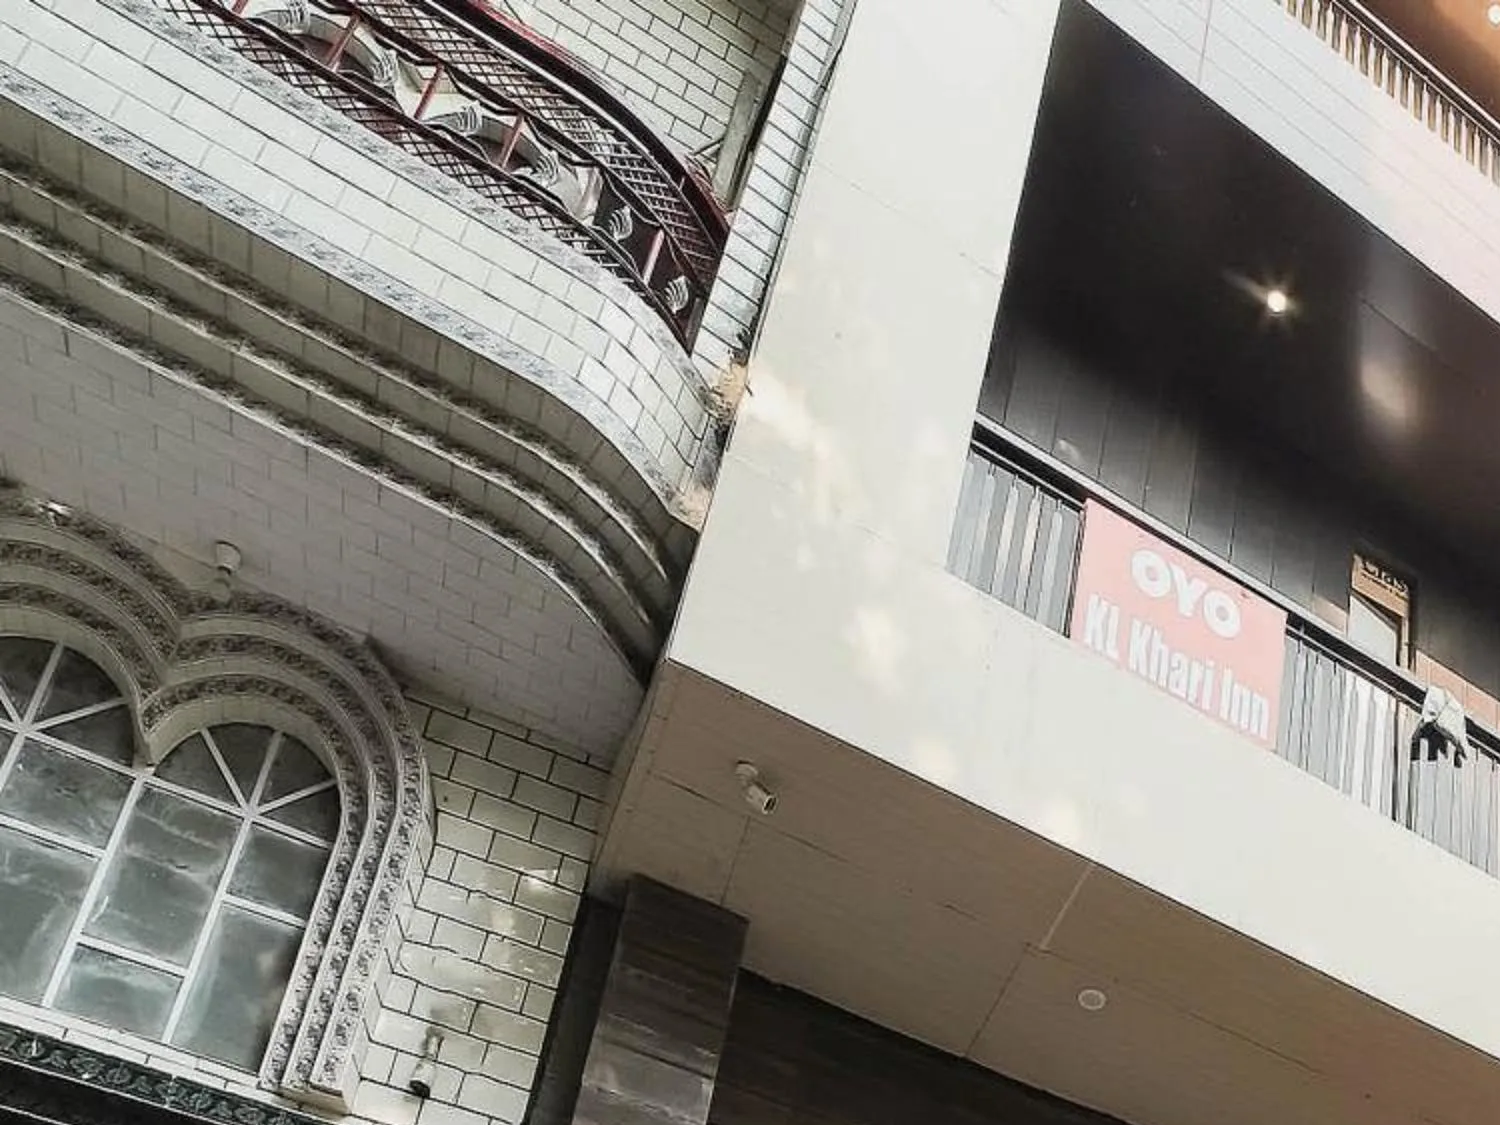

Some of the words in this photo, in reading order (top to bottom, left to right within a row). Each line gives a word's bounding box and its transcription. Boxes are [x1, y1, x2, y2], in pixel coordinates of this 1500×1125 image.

[1130, 549, 1242, 639] OYO
[1083, 592, 1120, 661] KL
[1128, 616, 1215, 712] Khari
[1218, 664, 1270, 741] Inn
